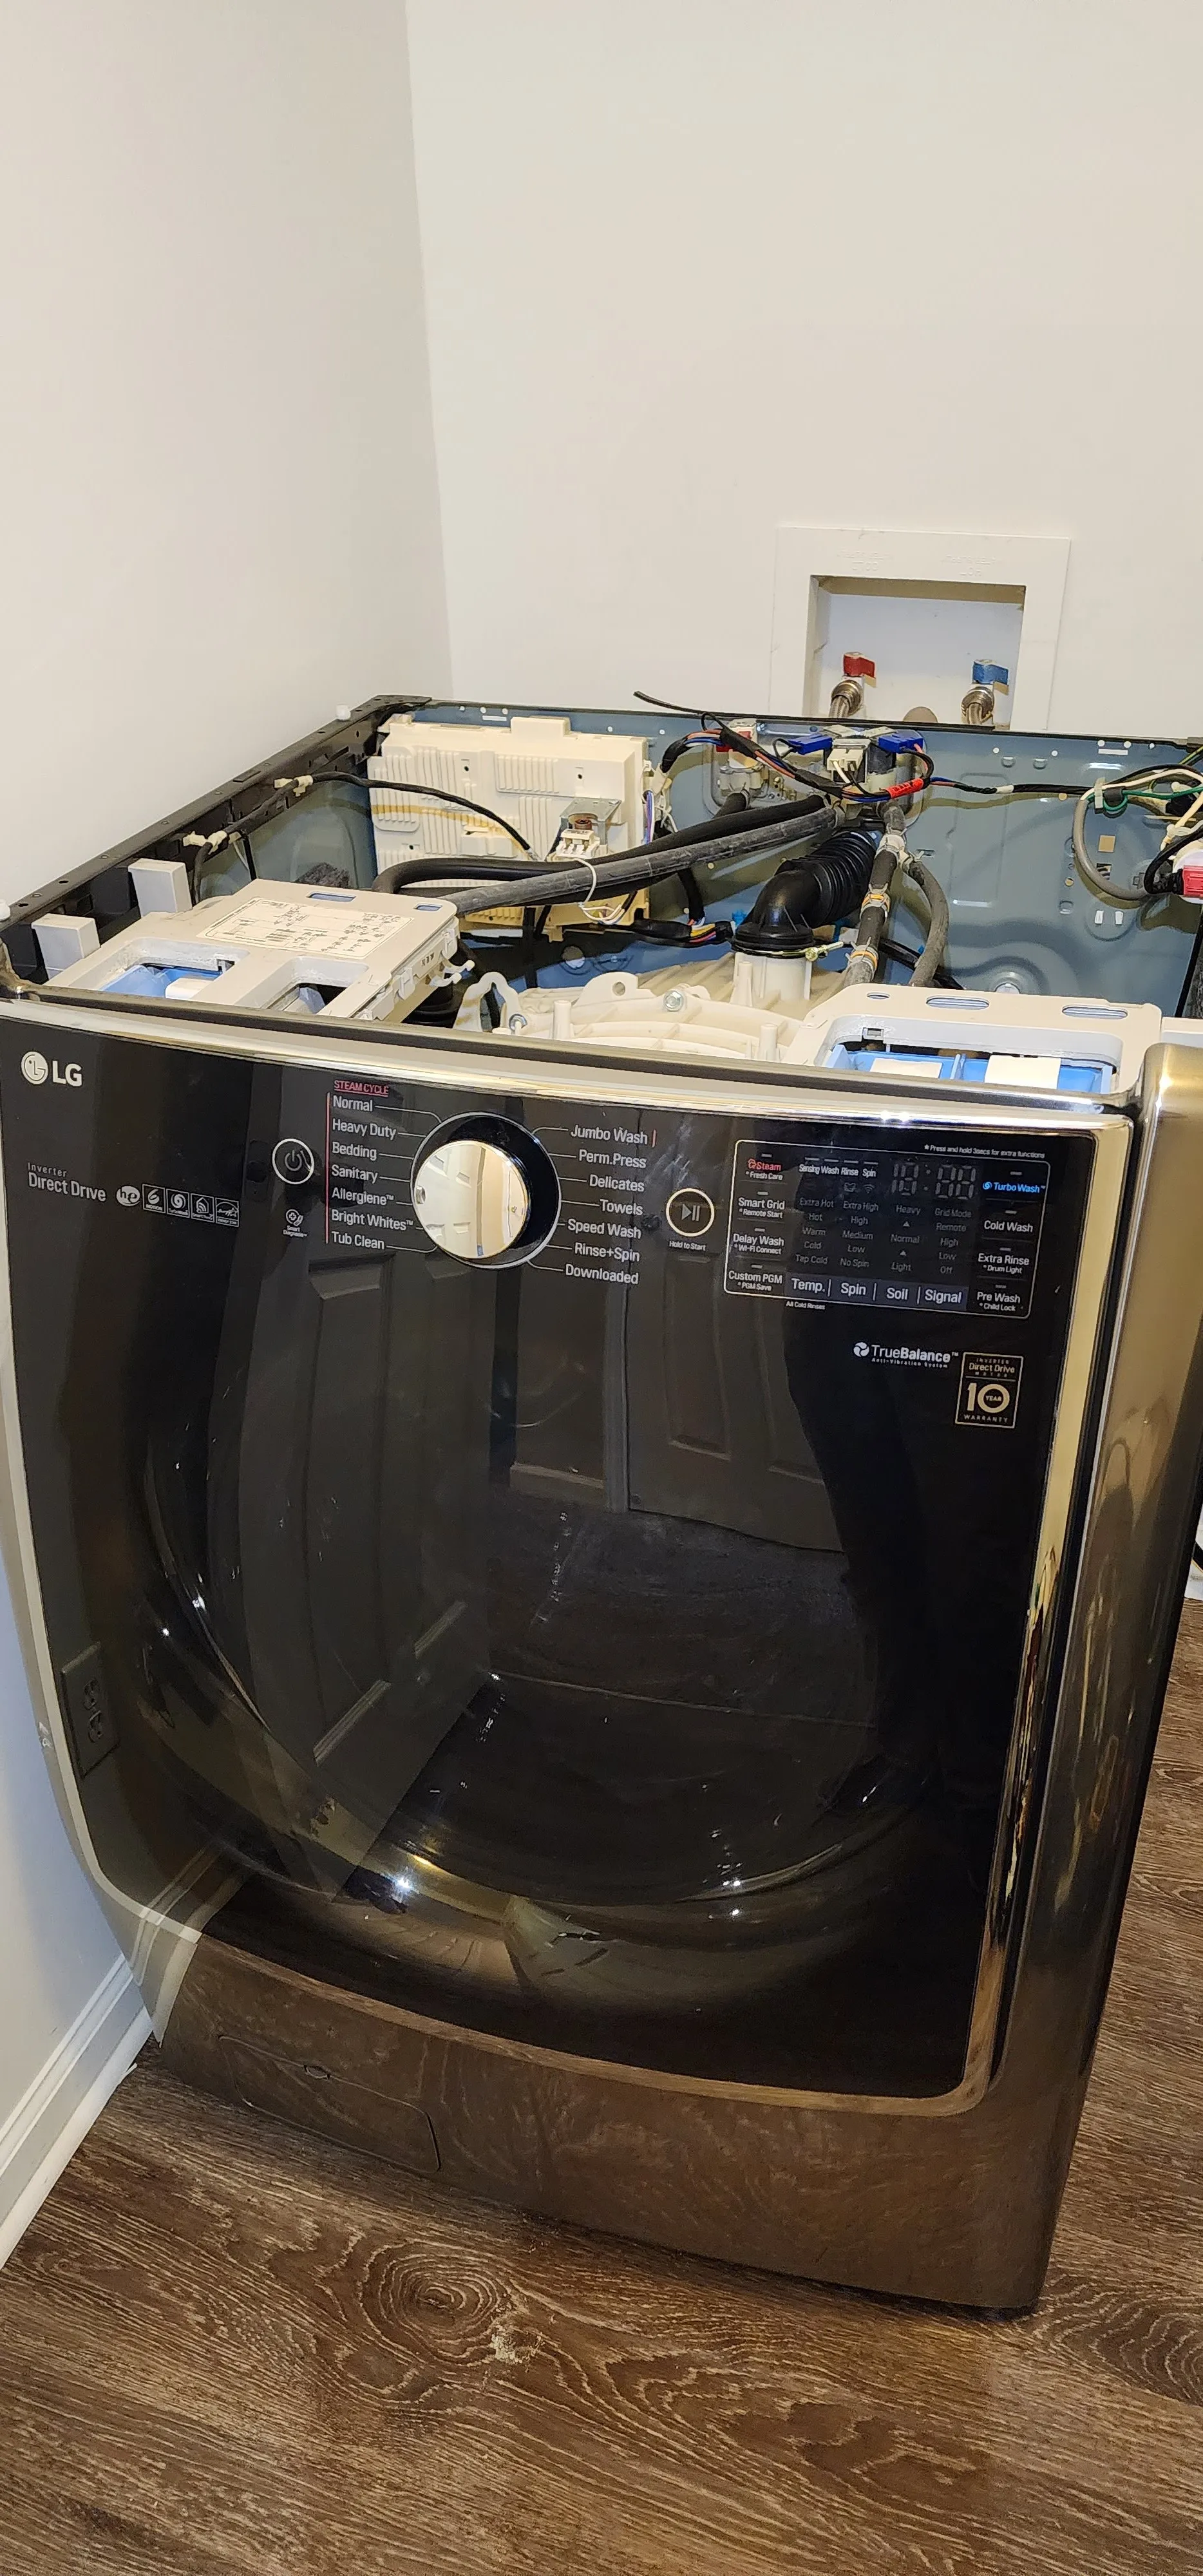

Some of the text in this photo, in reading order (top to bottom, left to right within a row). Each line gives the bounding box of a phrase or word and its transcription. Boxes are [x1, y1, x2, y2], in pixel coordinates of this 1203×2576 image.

[52, 1060, 82, 1086] LG
[334, 1080, 389, 1095] STEAM CYCLE
[333, 1095, 373, 1112] Normal
[332, 1119, 396, 1140] Heavy Duty
[571, 1124, 648, 1145] Jumbo Wash
[332, 1142, 377, 1160] Bedding
[579, 1150, 647, 1169] Perm.Press
[756, 1161, 781, 1171] Steam
[28, 1162, 67, 1178] Inverter
[332, 1164, 378, 1184] Sanitary
[821, 1166, 840, 1175] Wash
[840, 1167, 859, 1176] Rinse
[862, 1168, 876, 1178] Spin
[28, 1173, 106, 1202] Direct Drive
[589, 1174, 645, 1193] Delicates
[600, 1198, 643, 1216] Towels
[738, 1197, 785, 1210] Smart Grid
[821, 1198, 834, 1208] Hot
[863, 1202, 878, 1212] High
[896, 1204, 921, 1215] Heavy
[332, 1209, 365, 1226] Bright
[808, 1212, 822, 1221] Hot
[851, 1217, 868, 1226] High
[567, 1218, 641, 1239] Speed Wash
[802, 1227, 826, 1236] Warm
[984, 1220, 1033, 1233] Cold Wash
[332, 1231, 384, 1250] Tub Clean
[733, 1233, 784, 1247] Delay Wash
[842, 1230, 874, 1240] Medium
[891, 1234, 920, 1244] Normal
[690, 1243, 706, 1251] Start
[804, 1241, 822, 1250] Cold
[940, 1237, 959, 1247] High
[574, 1242, 639, 1262] Rinse+Spin
[848, 1245, 866, 1253] Low
[795, 1255, 809, 1264] Tap
[939, 1252, 957, 1260] Low
[978, 1253, 1030, 1265] Extra Rinse
[840, 1258, 869, 1269] No Spin
[891, 1262, 912, 1273] Light
[940, 1265, 953, 1274] Off
[1006, 1265, 1023, 1274] Light
[565, 1264, 639, 1285] Downloaded
[728, 1271, 782, 1283] Custom PGM
[791, 1278, 825, 1293] Temp.
[840, 1282, 866, 1296] Spin
[886, 1287, 909, 1300] Soil
[925, 1289, 962, 1304] Signal
[977, 1292, 1020, 1303] Pre Wash
[969, 1362, 1015, 1373] Direct Drive
[967, 1383, 1010, 1413] 10
